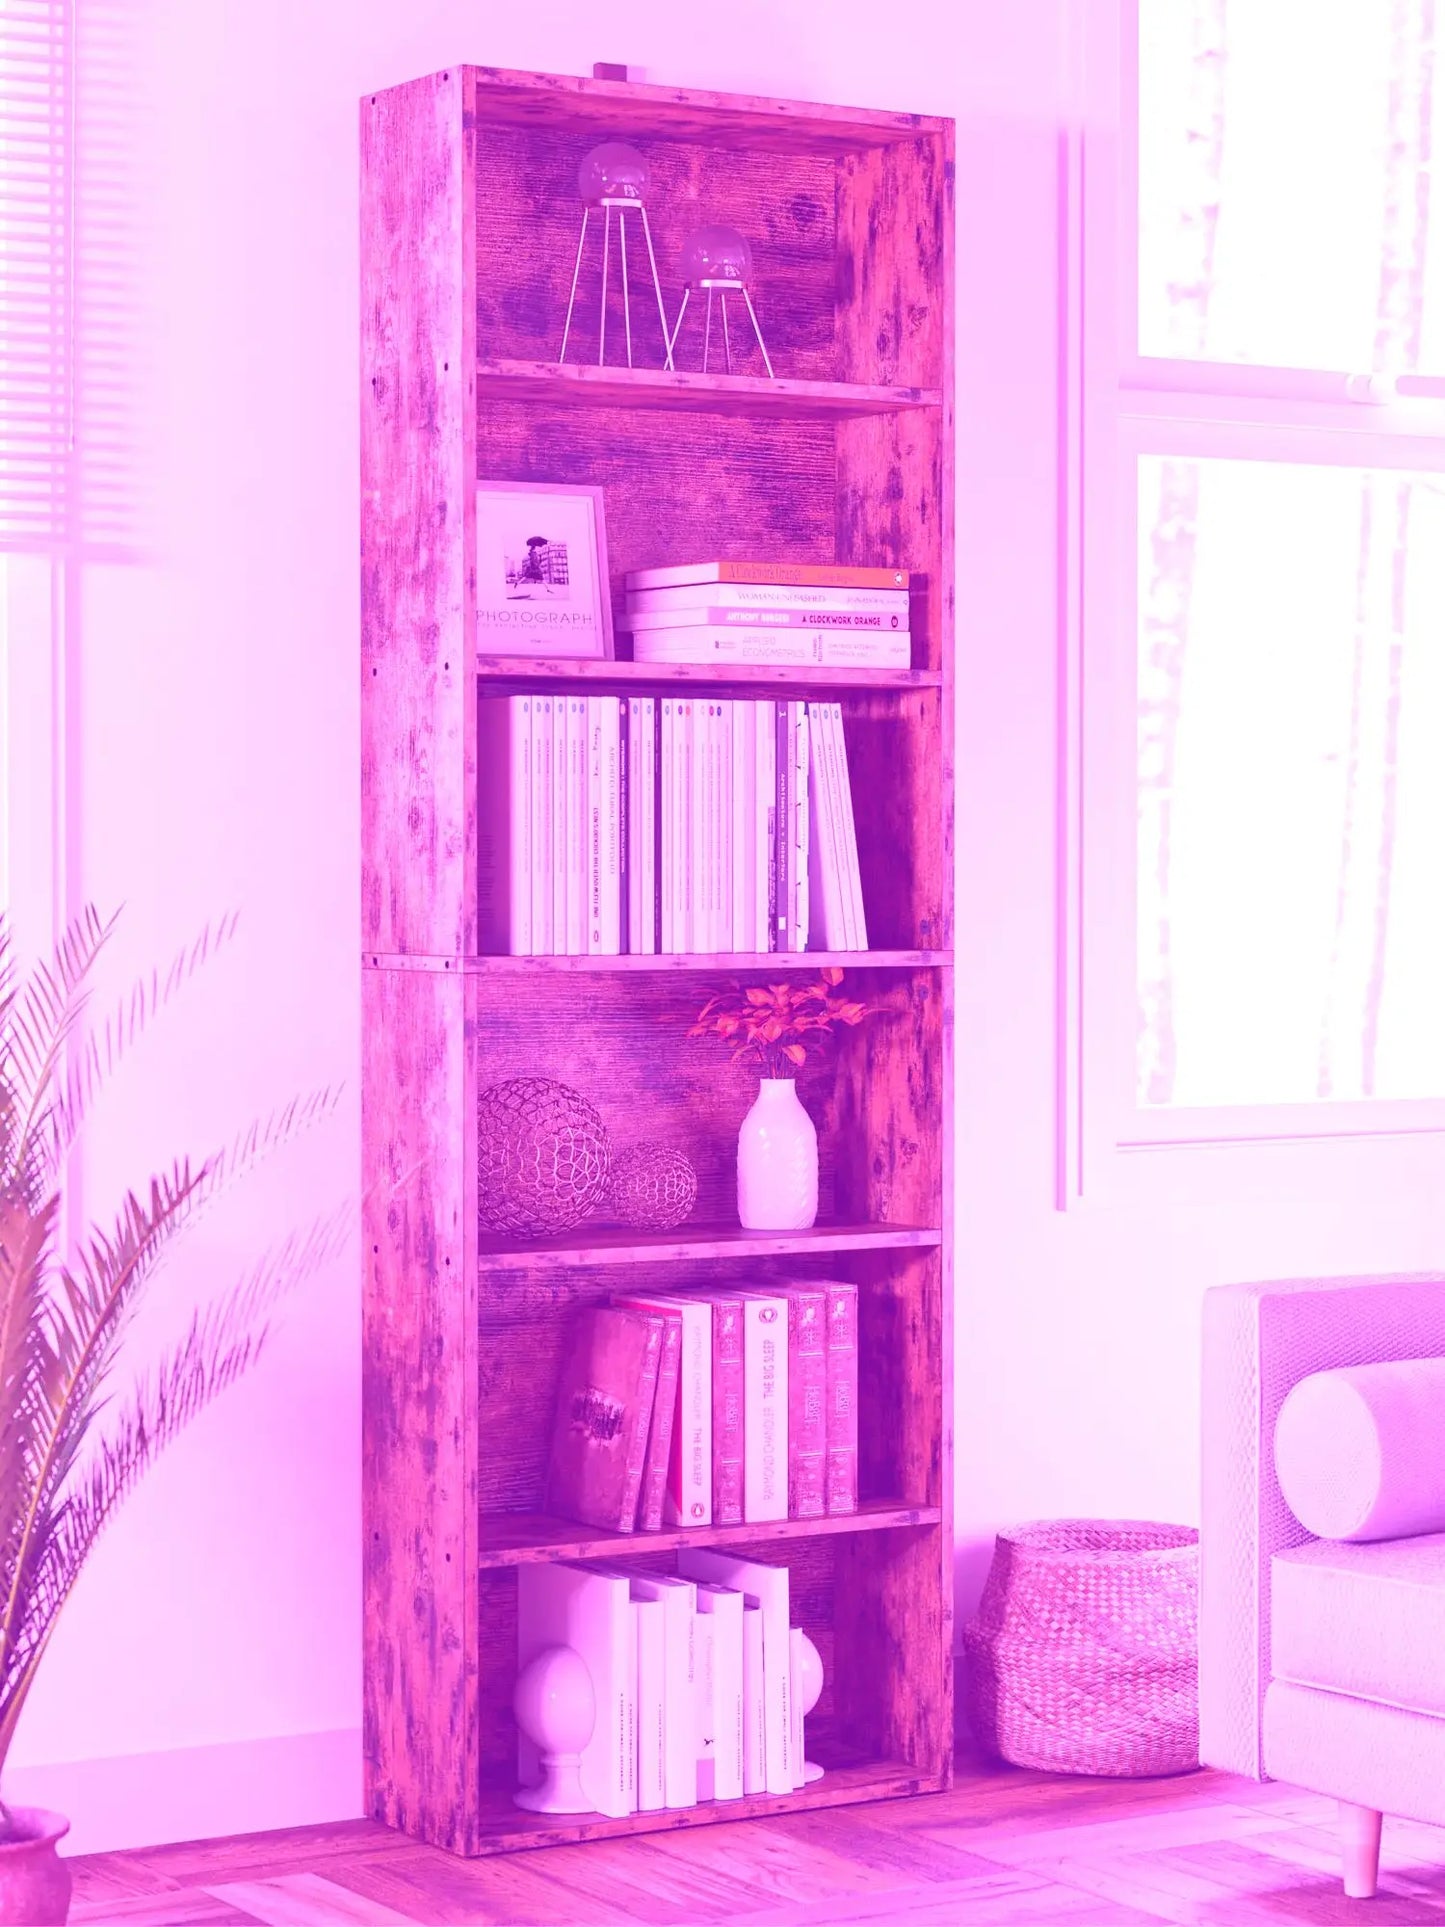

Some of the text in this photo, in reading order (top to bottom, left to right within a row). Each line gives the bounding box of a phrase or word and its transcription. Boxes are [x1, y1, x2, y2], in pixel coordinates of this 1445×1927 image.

[802, 615, 807, 623] A
[809, 615, 852, 625] CLOCKWORK
[854, 616, 881, 626] ORANGE
[763, 1338, 775, 1363] SLEEP
[763, 1364, 775, 1380] BIG
[763, 1381, 775, 1400] THE
